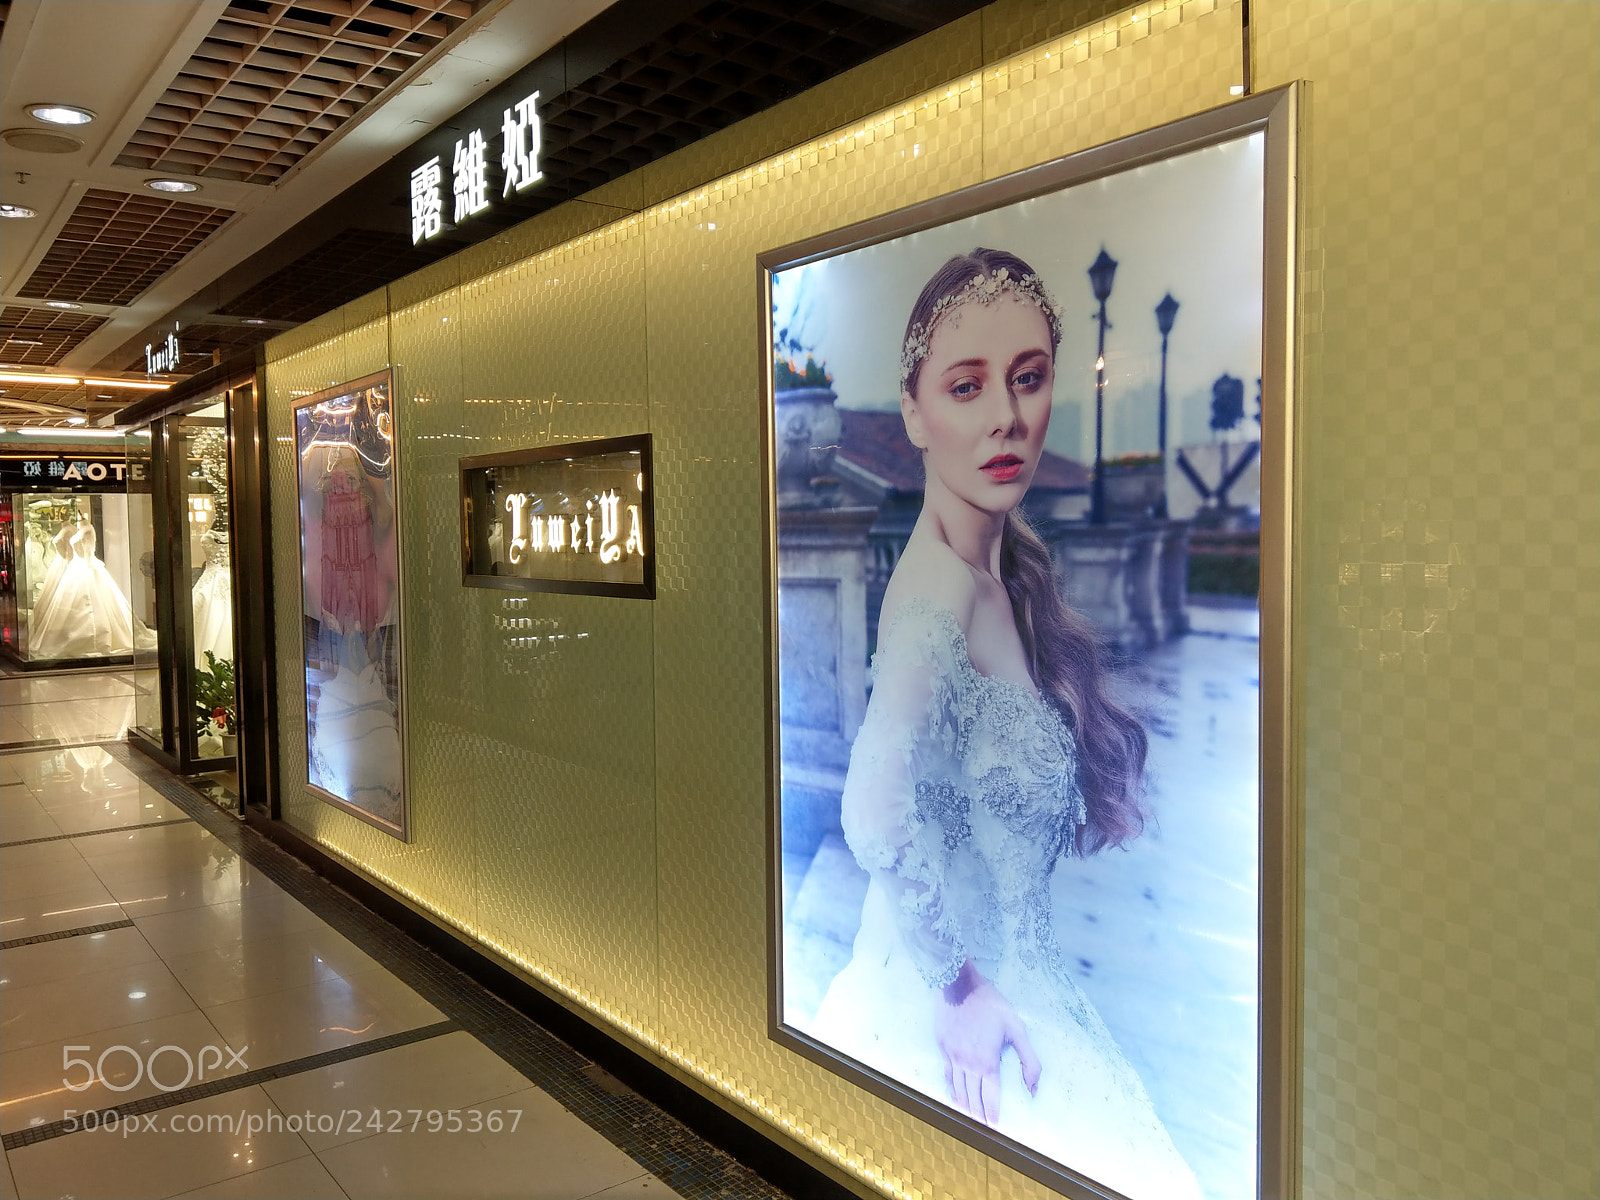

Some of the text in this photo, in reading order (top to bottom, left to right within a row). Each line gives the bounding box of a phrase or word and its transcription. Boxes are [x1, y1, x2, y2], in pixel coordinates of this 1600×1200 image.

[410, 90, 543, 246] 露維婭
[62, 462, 146, 481] AOTE
